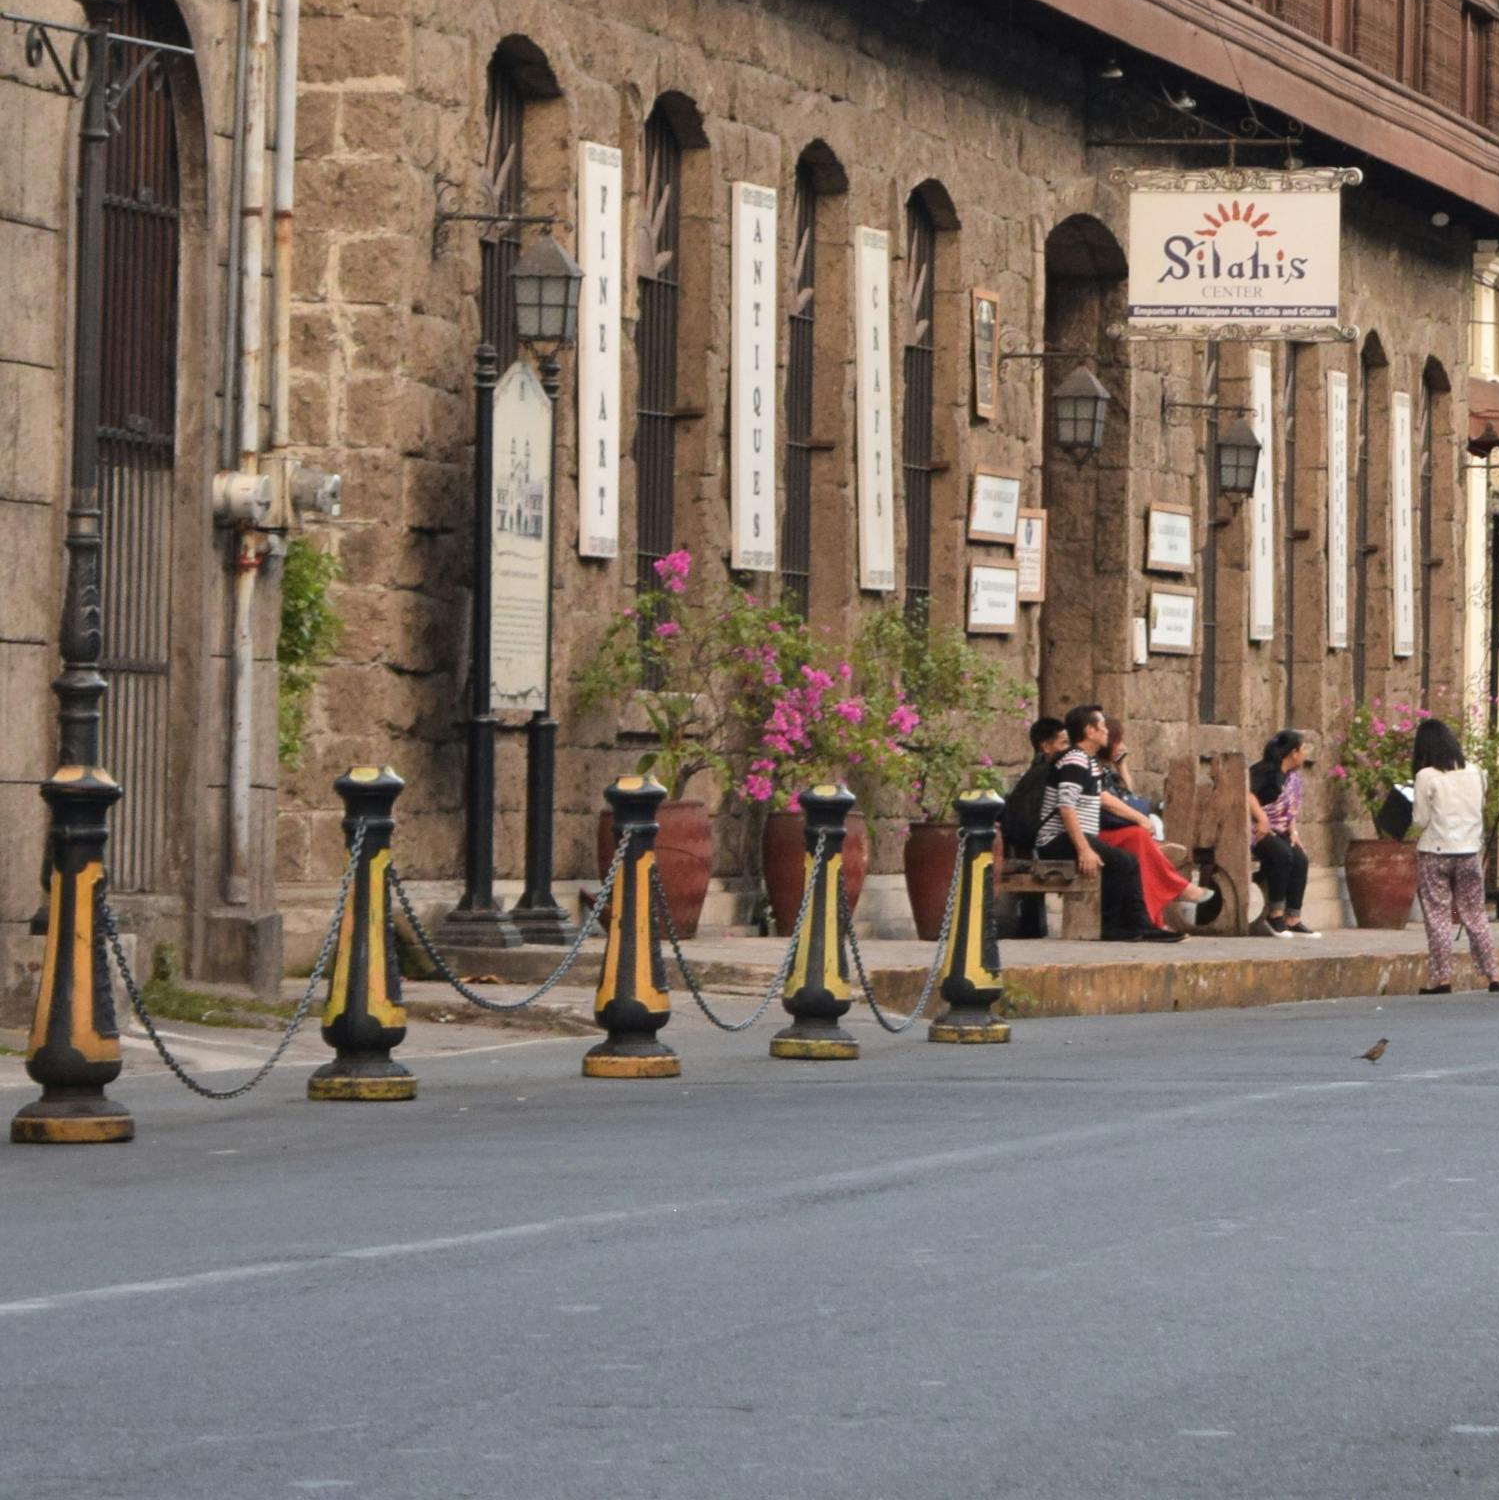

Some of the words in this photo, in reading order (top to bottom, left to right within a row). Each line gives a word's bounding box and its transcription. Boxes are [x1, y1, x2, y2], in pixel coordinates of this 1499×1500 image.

[598, 185, 608, 353] FINE
[1133, 307, 1177, 317] Emporium
[1178, 307, 1187, 316] of
[1188, 307, 1230, 317] Philippine
[1254, 307, 1280, 316] Crafts
[1282, 307, 1298, 316] and
[1300, 307, 1331, 316] Culture
[1157, 235, 1308, 284] Silahis
[1202, 286, 1263, 299] CENTER
[753, 218, 763, 538] ANTIQUES
[872, 284, 882, 517] CRAFTS
[598, 390, 607, 516] ART
